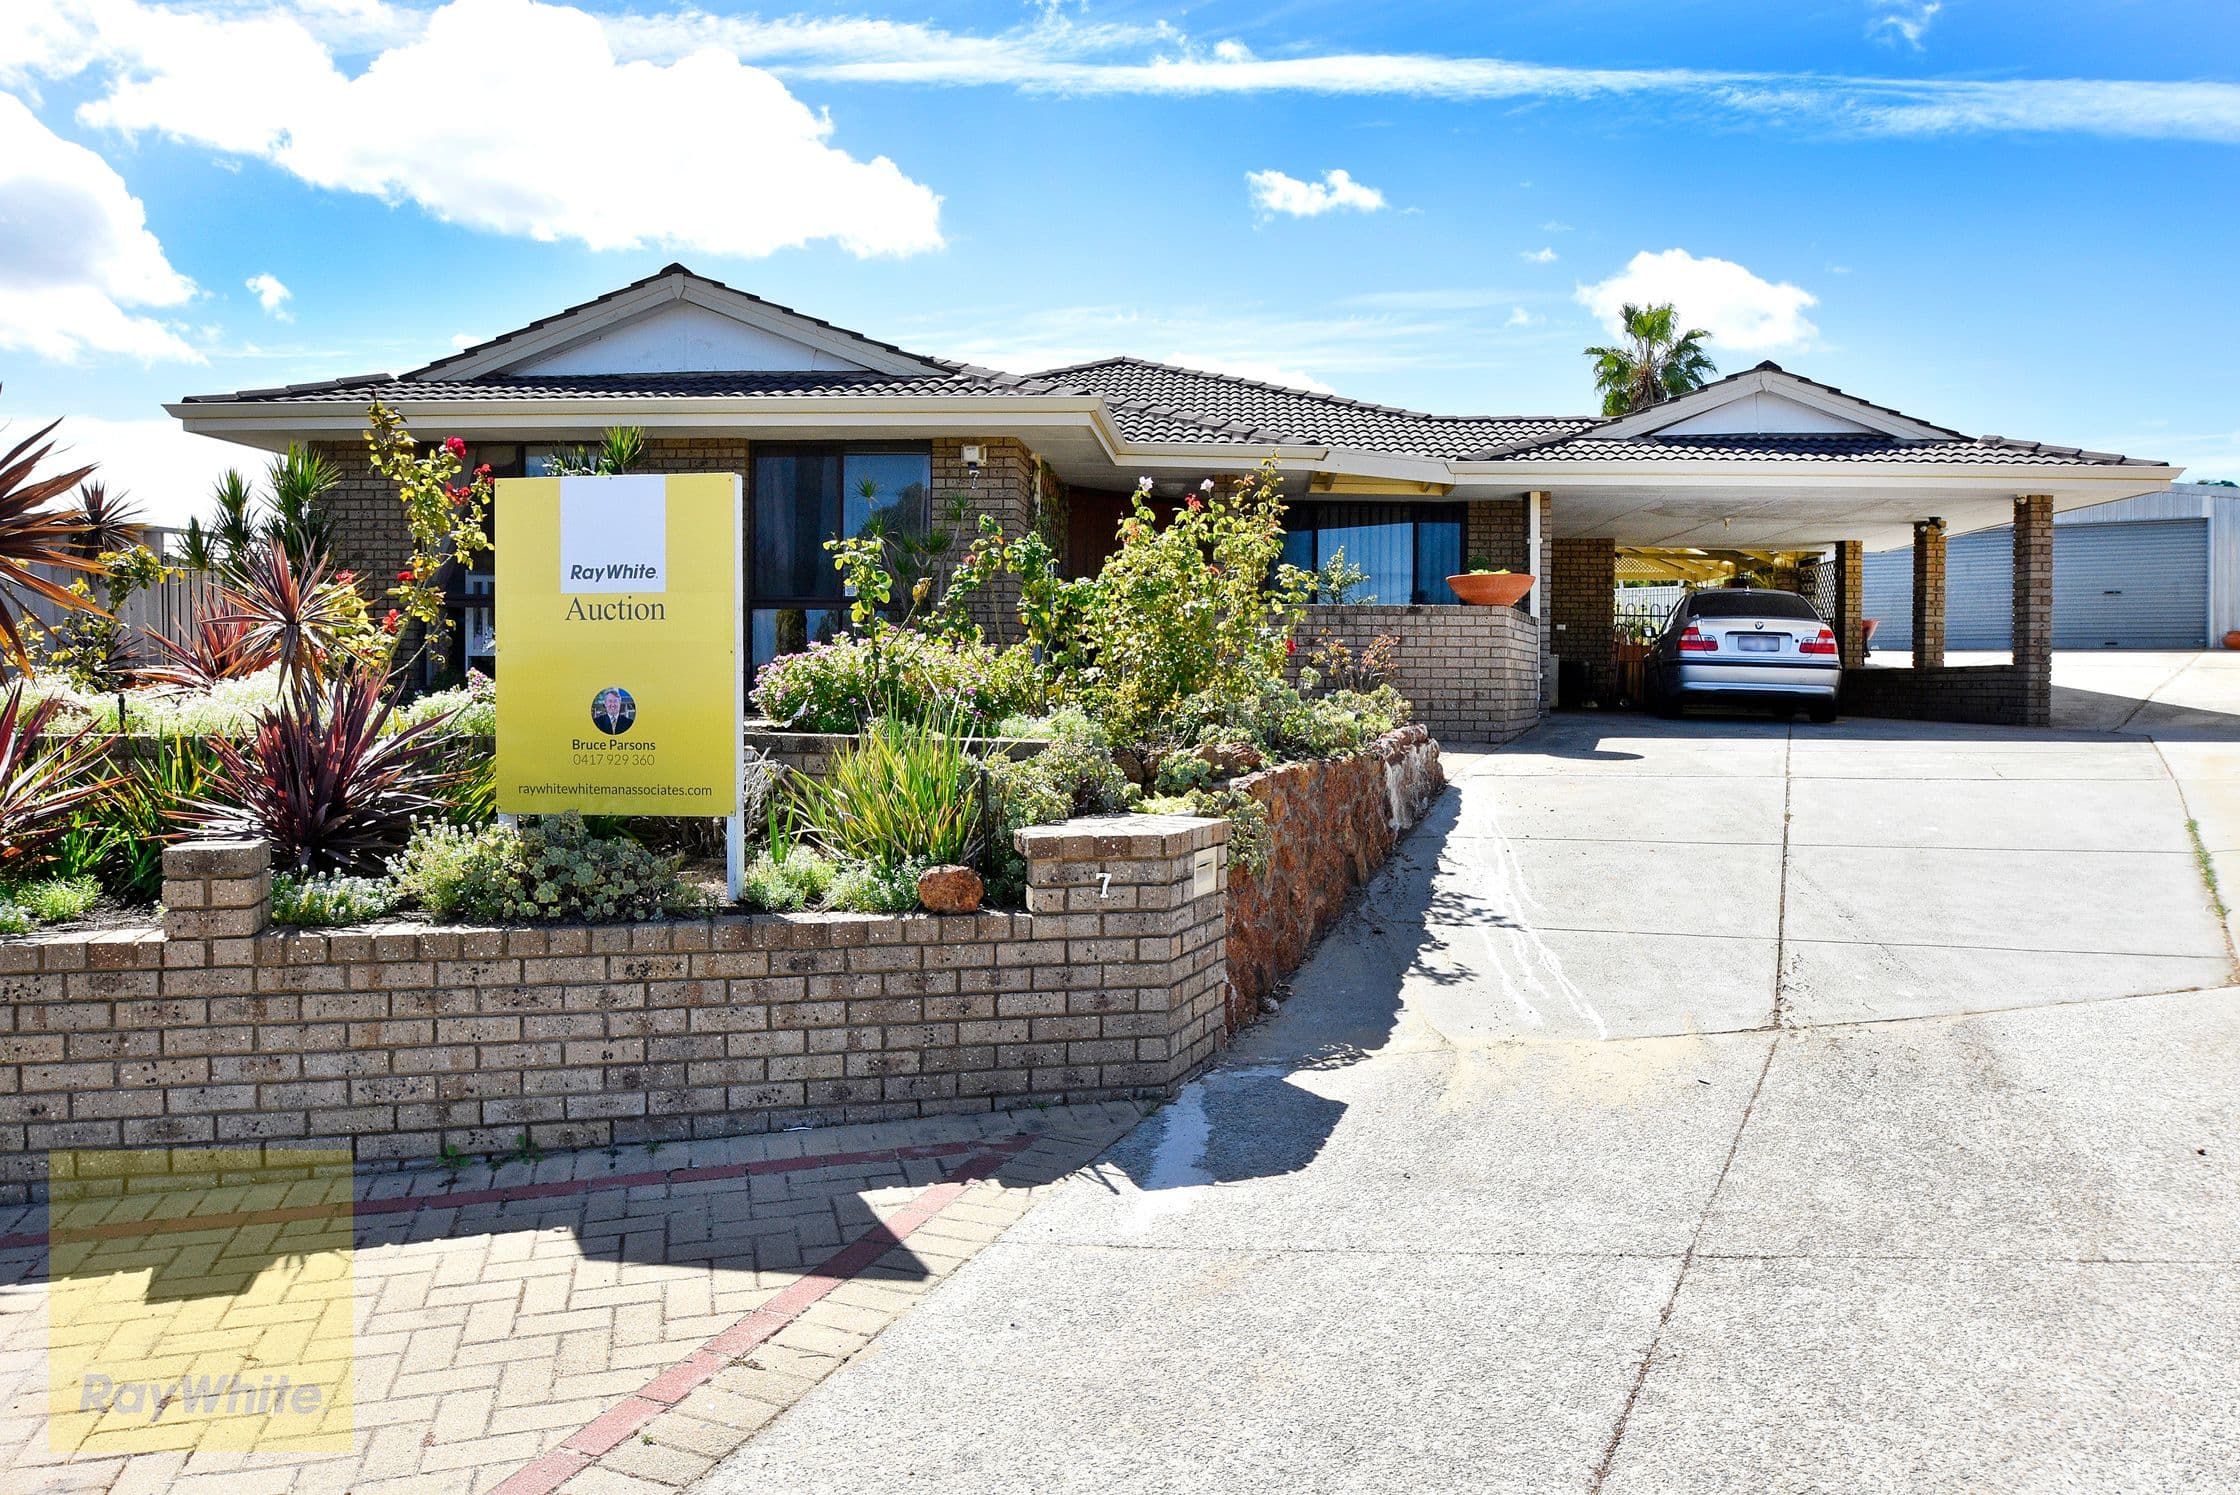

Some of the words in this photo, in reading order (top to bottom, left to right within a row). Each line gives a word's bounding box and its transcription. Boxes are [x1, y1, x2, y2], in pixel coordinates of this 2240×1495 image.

[565, 595, 666, 621] Auction
[572, 739, 606, 750] Bruce
[609, 739, 656, 751] Parsons
[573, 754, 603, 765] 0417
[607, 754, 629, 766] 929
[632, 754, 655, 766] 360
[518, 783, 712, 797] raywhitewhitemanassociates.com
[1096, 872, 1112, 898] 7
